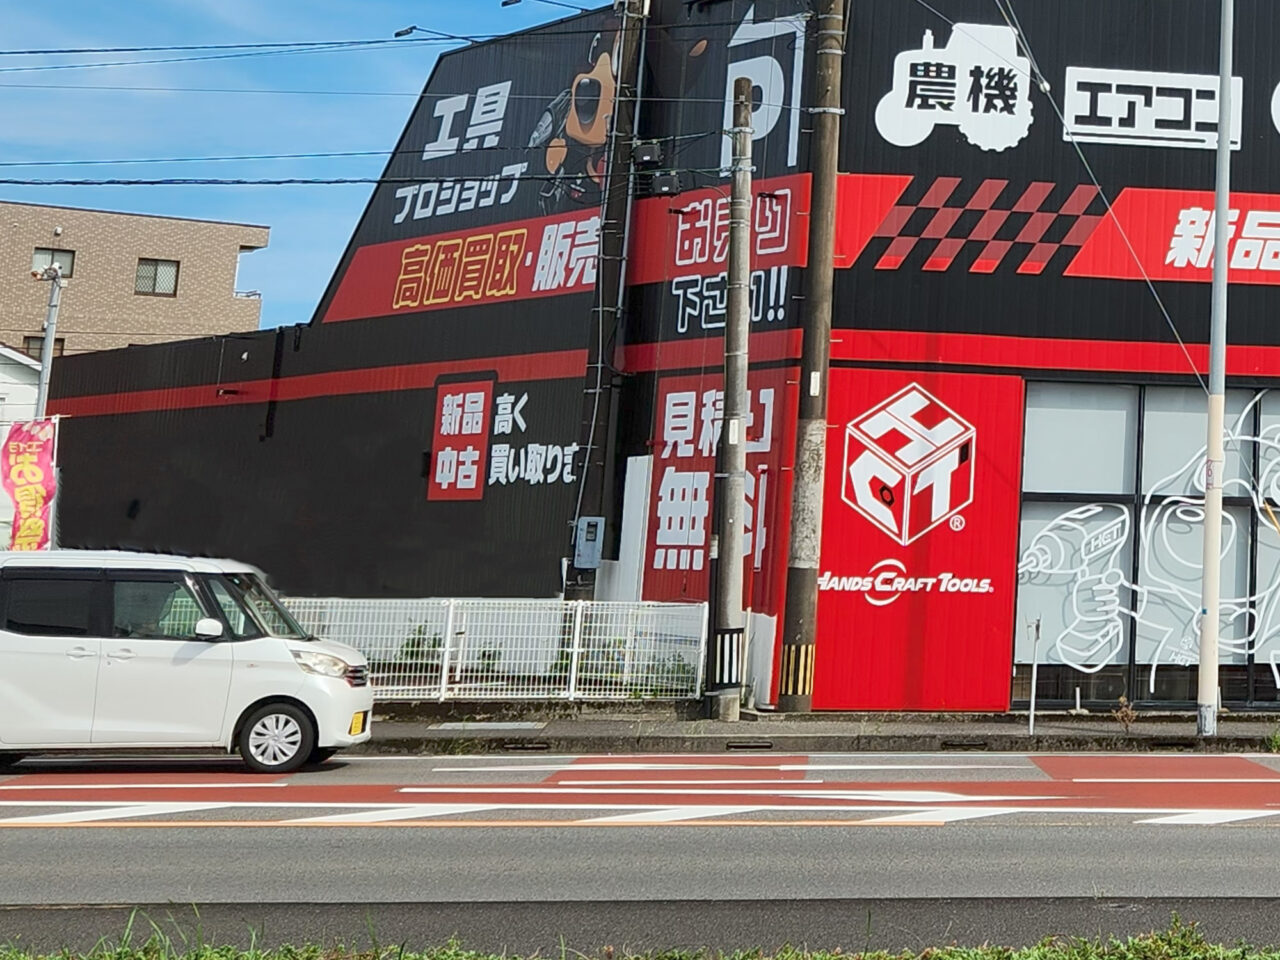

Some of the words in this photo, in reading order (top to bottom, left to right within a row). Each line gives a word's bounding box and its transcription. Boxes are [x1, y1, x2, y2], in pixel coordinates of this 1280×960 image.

[905, 61, 1018, 116] 農機
[422, 80, 513, 161] 工具
[394, 161, 529, 224] プロショップ
[440, 391, 485, 435] 新品
[493, 392, 529, 435] 高く
[435, 445, 480, 490] 中古
[874, 571, 937, 592] CRAFT
